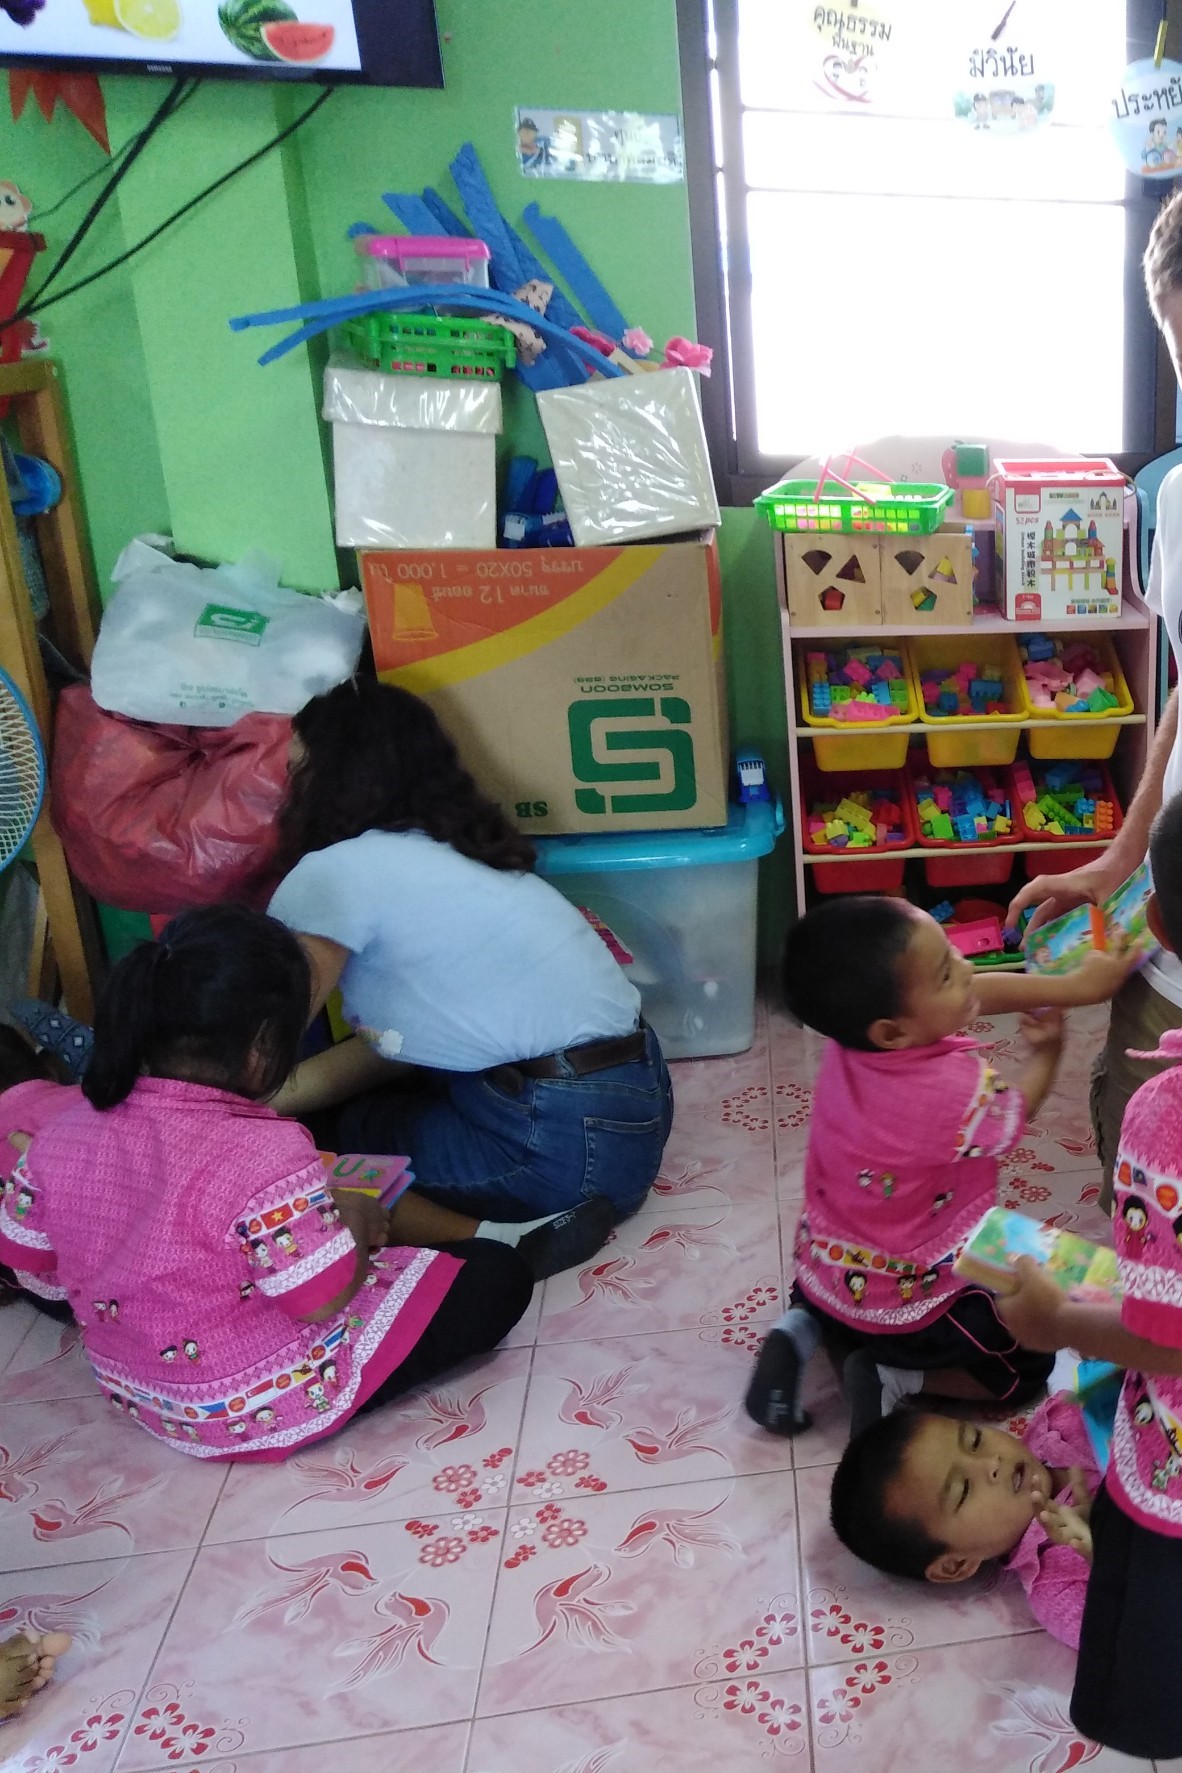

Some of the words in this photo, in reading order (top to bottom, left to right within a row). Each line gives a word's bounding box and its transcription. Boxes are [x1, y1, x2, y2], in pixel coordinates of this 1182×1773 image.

[813, 5, 892, 41] คุณธรรม
[969, 47, 1035, 78] มีวินัย
[477, 561, 534, 577] 50X20
[479, 585, 505, 604] 12
[514, 801, 548, 818] SB
